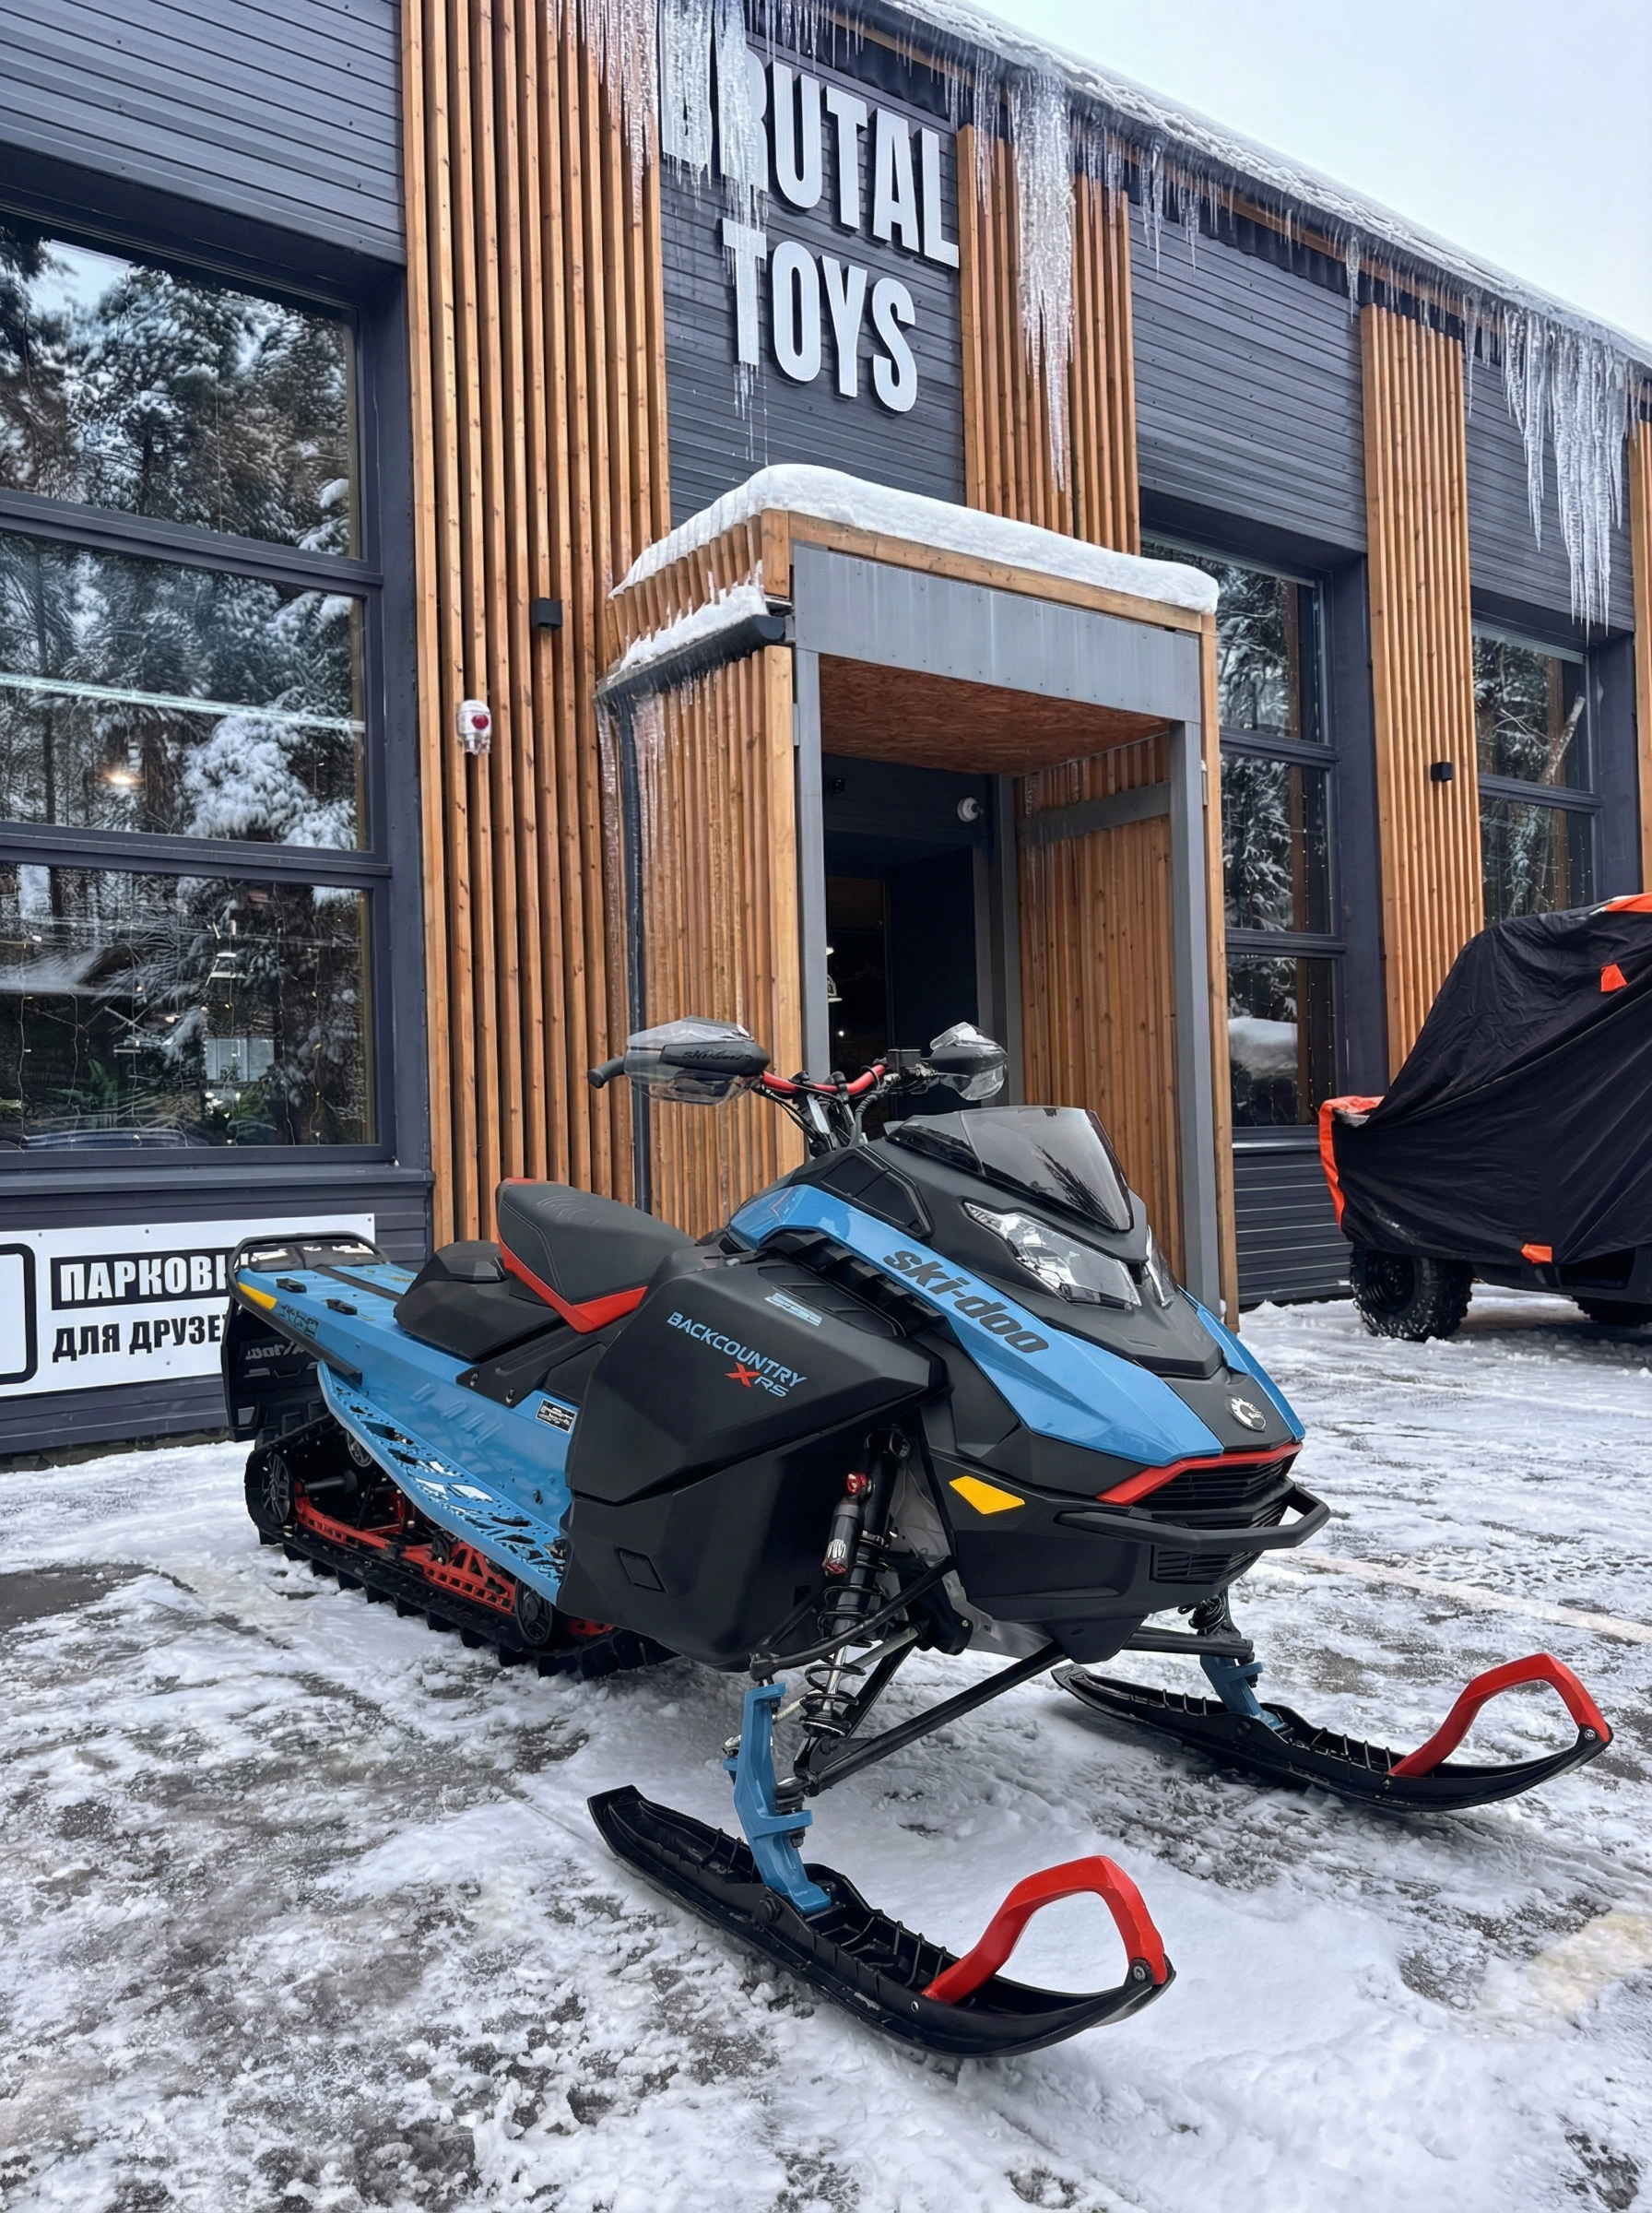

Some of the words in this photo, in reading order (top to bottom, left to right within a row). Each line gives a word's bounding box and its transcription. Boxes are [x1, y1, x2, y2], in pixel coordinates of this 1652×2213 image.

[659, 15, 960, 269] RUTAL
[722, 218, 918, 413] TOYS
[52, 1322, 121, 1363] ДЛЯ
[129, 1314, 227, 1355] ДРУЗЕ
[667, 1311, 808, 1387] BACKCOUNTRY
